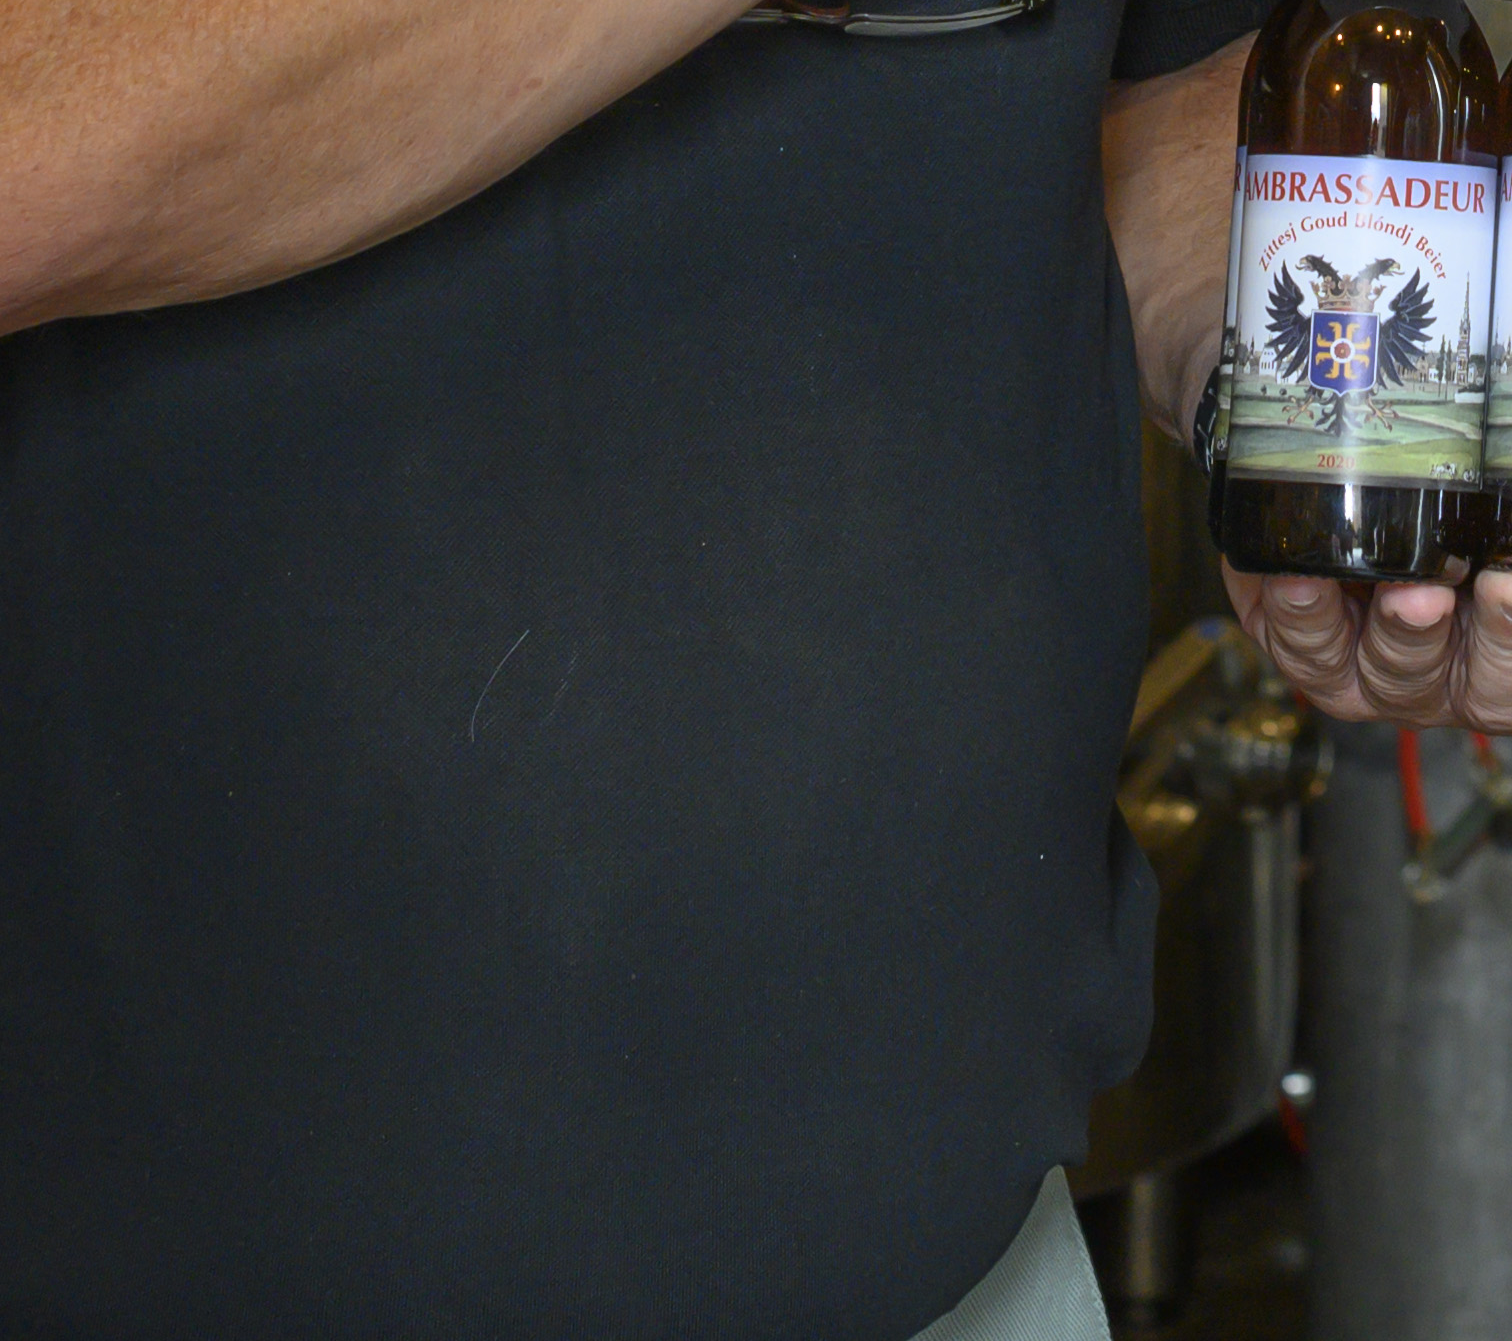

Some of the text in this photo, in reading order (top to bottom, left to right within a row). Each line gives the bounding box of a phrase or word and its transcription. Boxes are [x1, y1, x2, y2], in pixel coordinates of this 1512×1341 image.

[1245, 171, 1486, 214] AMBRASSADEUR
[1259, 222, 1298, 272] Zittesj
[1300, 211, 1348, 233] Goud
[1415, 235, 1447, 280] Beier
[1316, 453, 1355, 470] 2020
